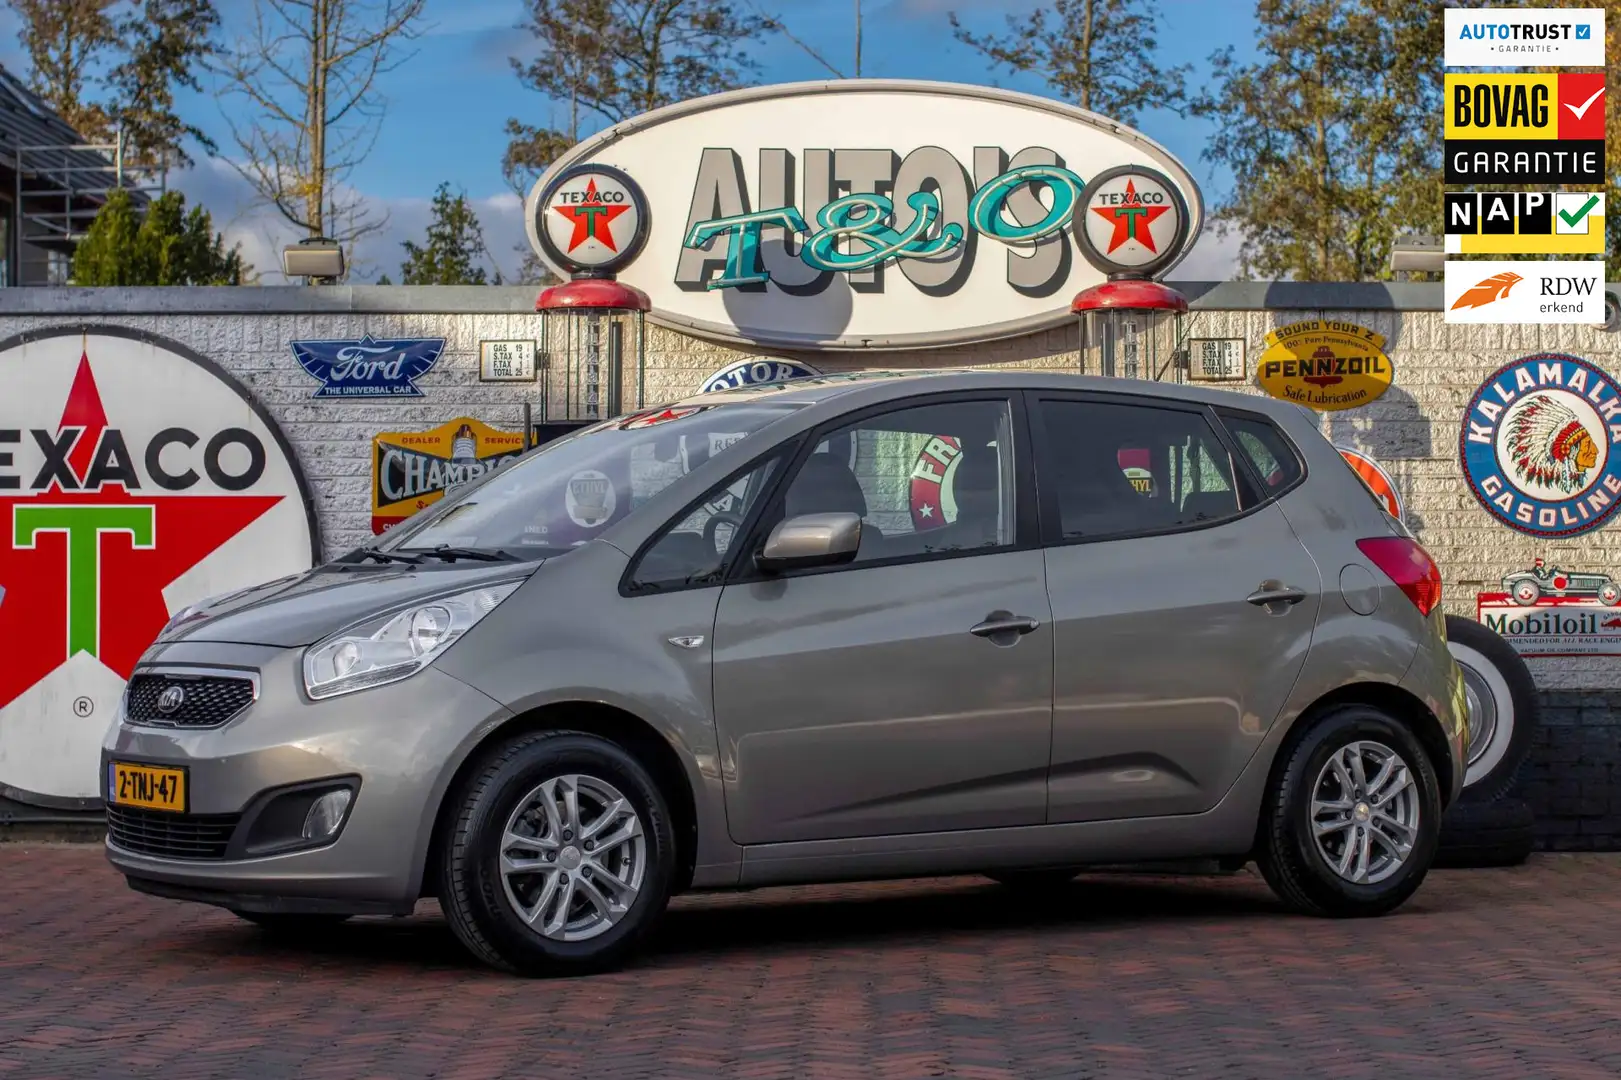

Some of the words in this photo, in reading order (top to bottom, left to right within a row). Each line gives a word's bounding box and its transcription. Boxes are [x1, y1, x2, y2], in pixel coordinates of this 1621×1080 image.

[560, 191, 624, 203] TEXACO
[1099, 192, 1164, 205] TEXACO
[1275, 321, 1319, 339] SOUND
[1323, 321, 1359, 334] YOUR
[493, 344, 508, 352] GAS
[1202, 342, 1216, 350] GAS
[330, 346, 406, 381] Ford
[493, 369, 513, 377] TOTAL
[1265, 357, 1385, 378] PENNZOIL
[709, 362, 794, 392] OTOR
[324, 386, 341, 395] THE
[343, 386, 390, 394] UNIVERSAL
[393, 385, 412, 393] CAR
[1282, 384, 1306, 402] Safe
[1307, 389, 1368, 404] Lubrication
[402, 436, 441, 444] DEALER
[484, 436, 524, 444] SERVIC
[0, 427, 267, 491] EXACO
[380, 449, 522, 500] CHAMPI
[1480, 472, 1621, 528] GASOLINE
[1484, 612, 1598, 635] Mobiloil
[119, 770, 177, 804] 2-TNJ-47
